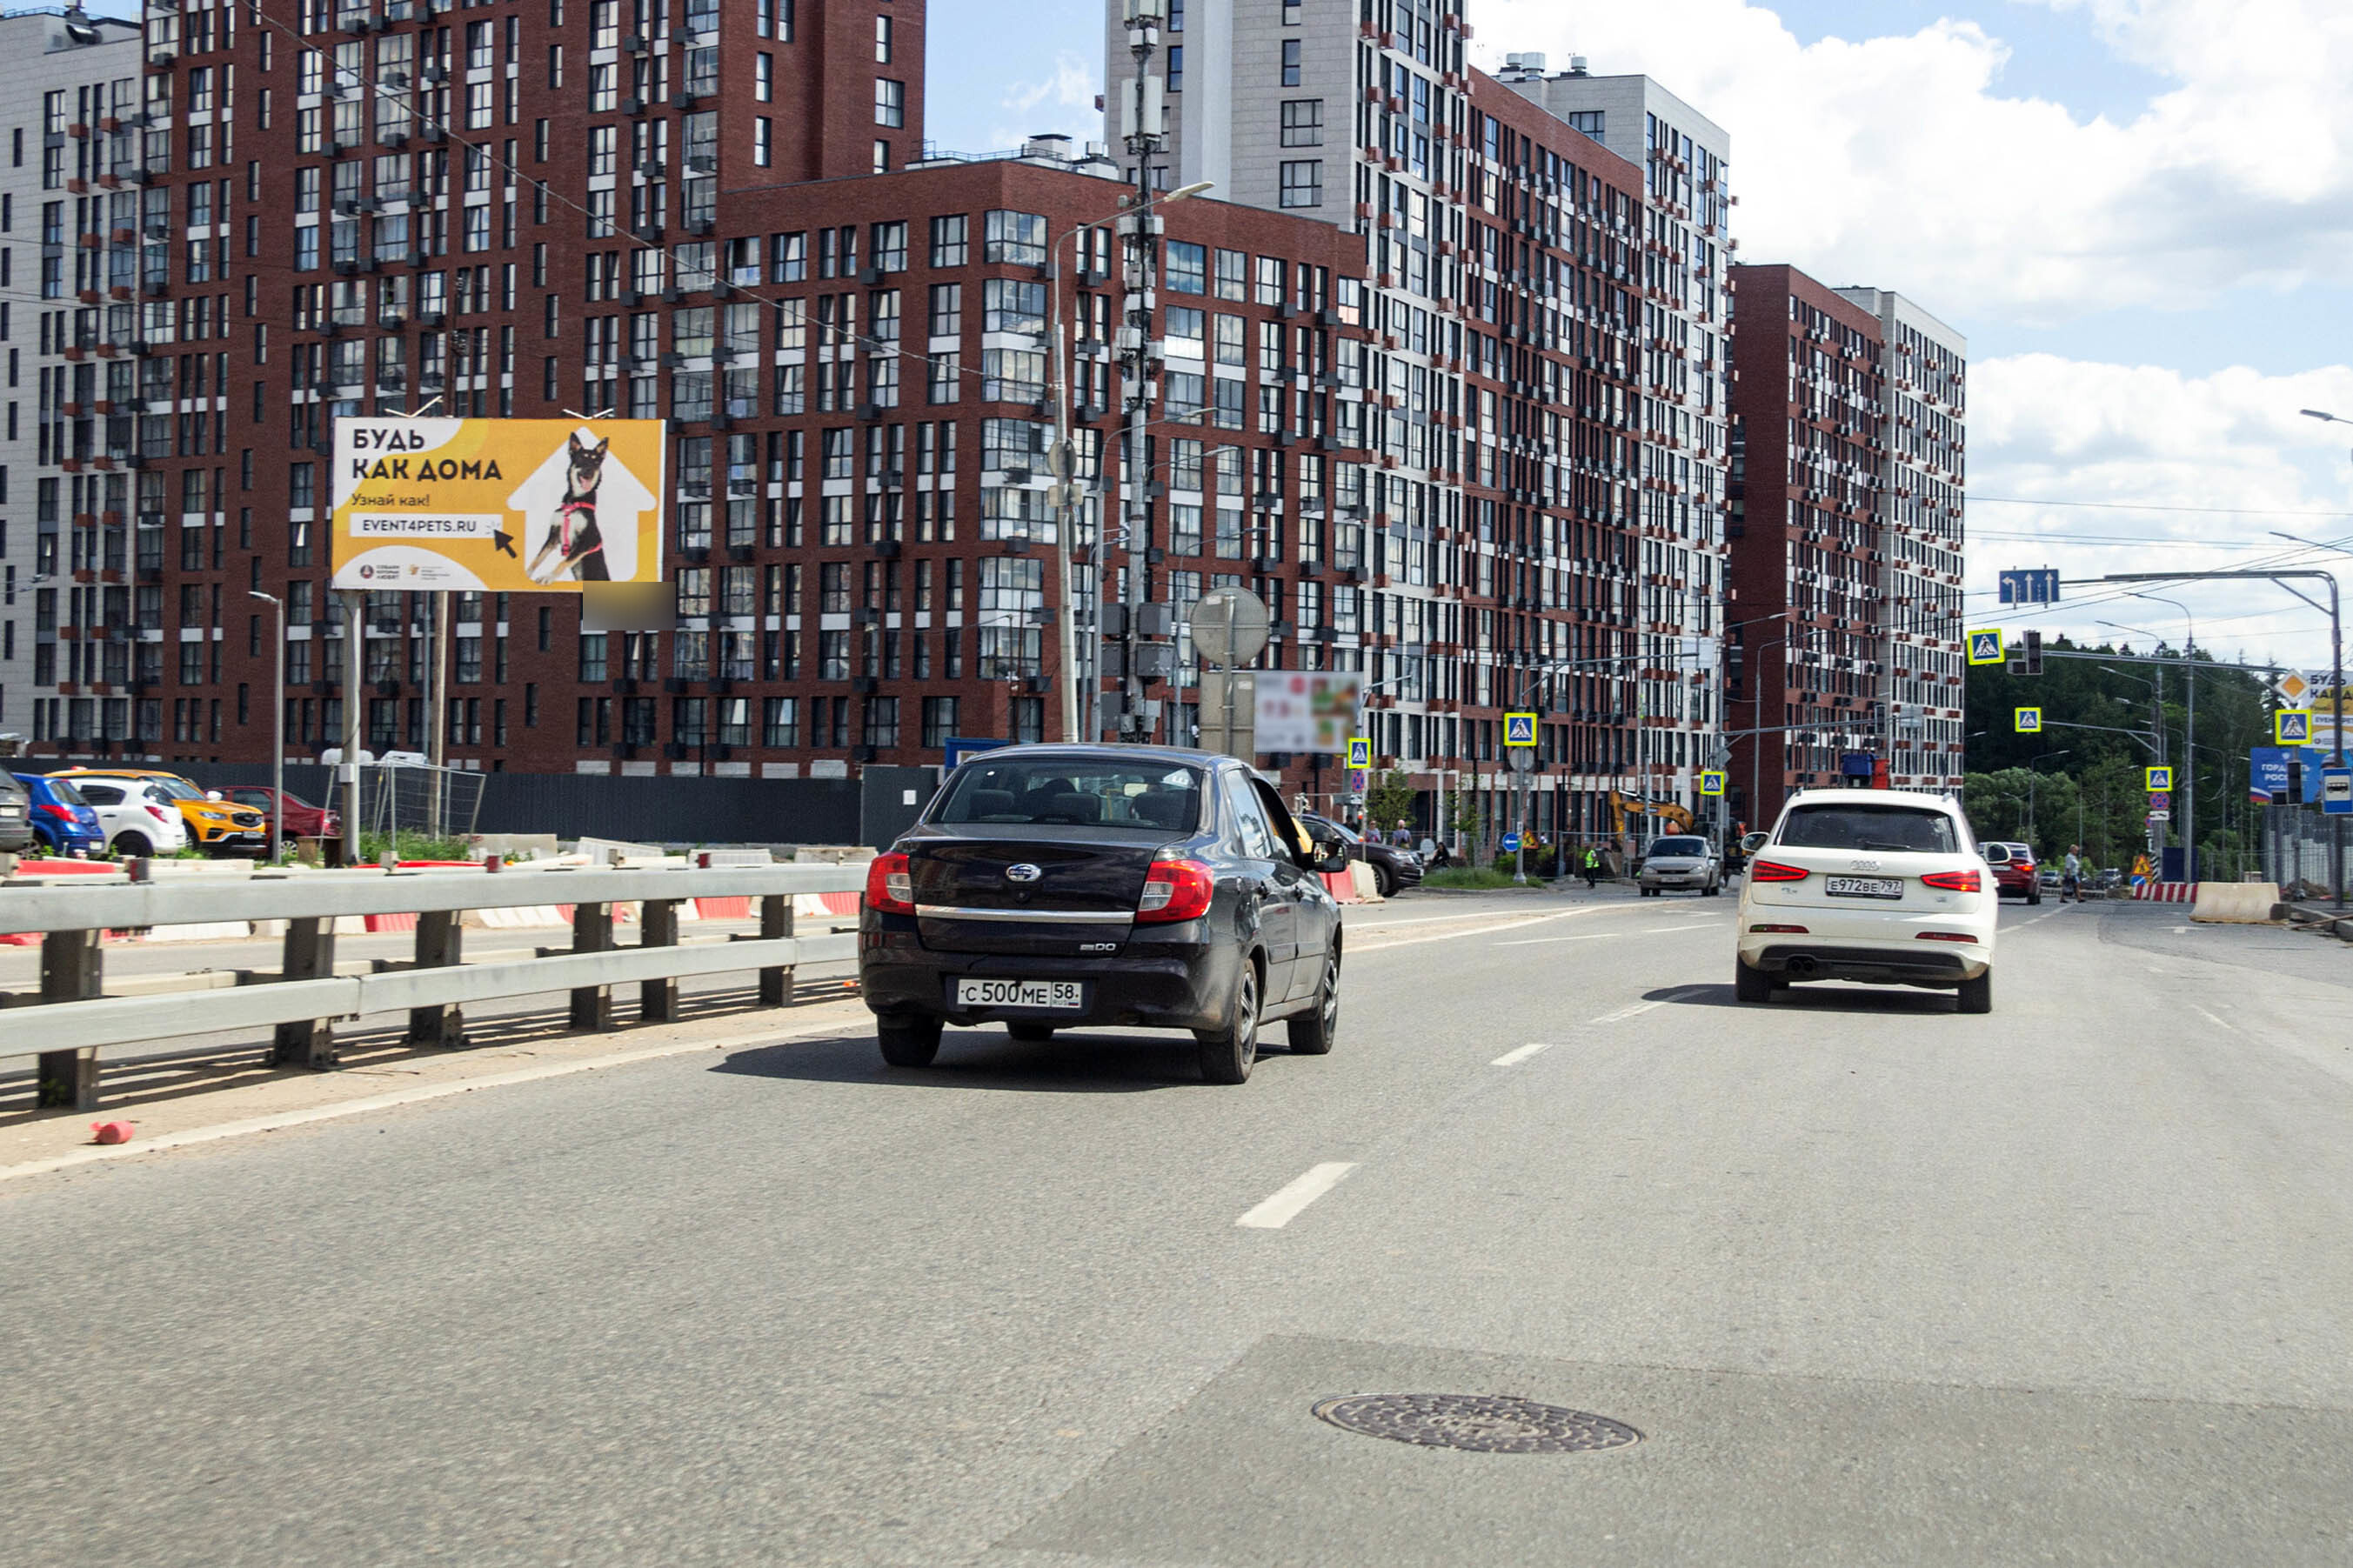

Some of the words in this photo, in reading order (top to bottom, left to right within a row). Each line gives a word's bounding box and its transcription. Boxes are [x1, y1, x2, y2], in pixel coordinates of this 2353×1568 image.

[353, 429, 424, 450] БУДЬ
[352, 458, 409, 479] КАК
[418, 459, 502, 482] ДОМА
[351, 493, 394, 506] Узнай
[399, 494, 430, 507] как!
[362, 519, 477, 532] EVENT4PETS.RU
[2262, 764, 2310, 772] ГОРДТЬ
[1053, 984, 1074, 999] 58
